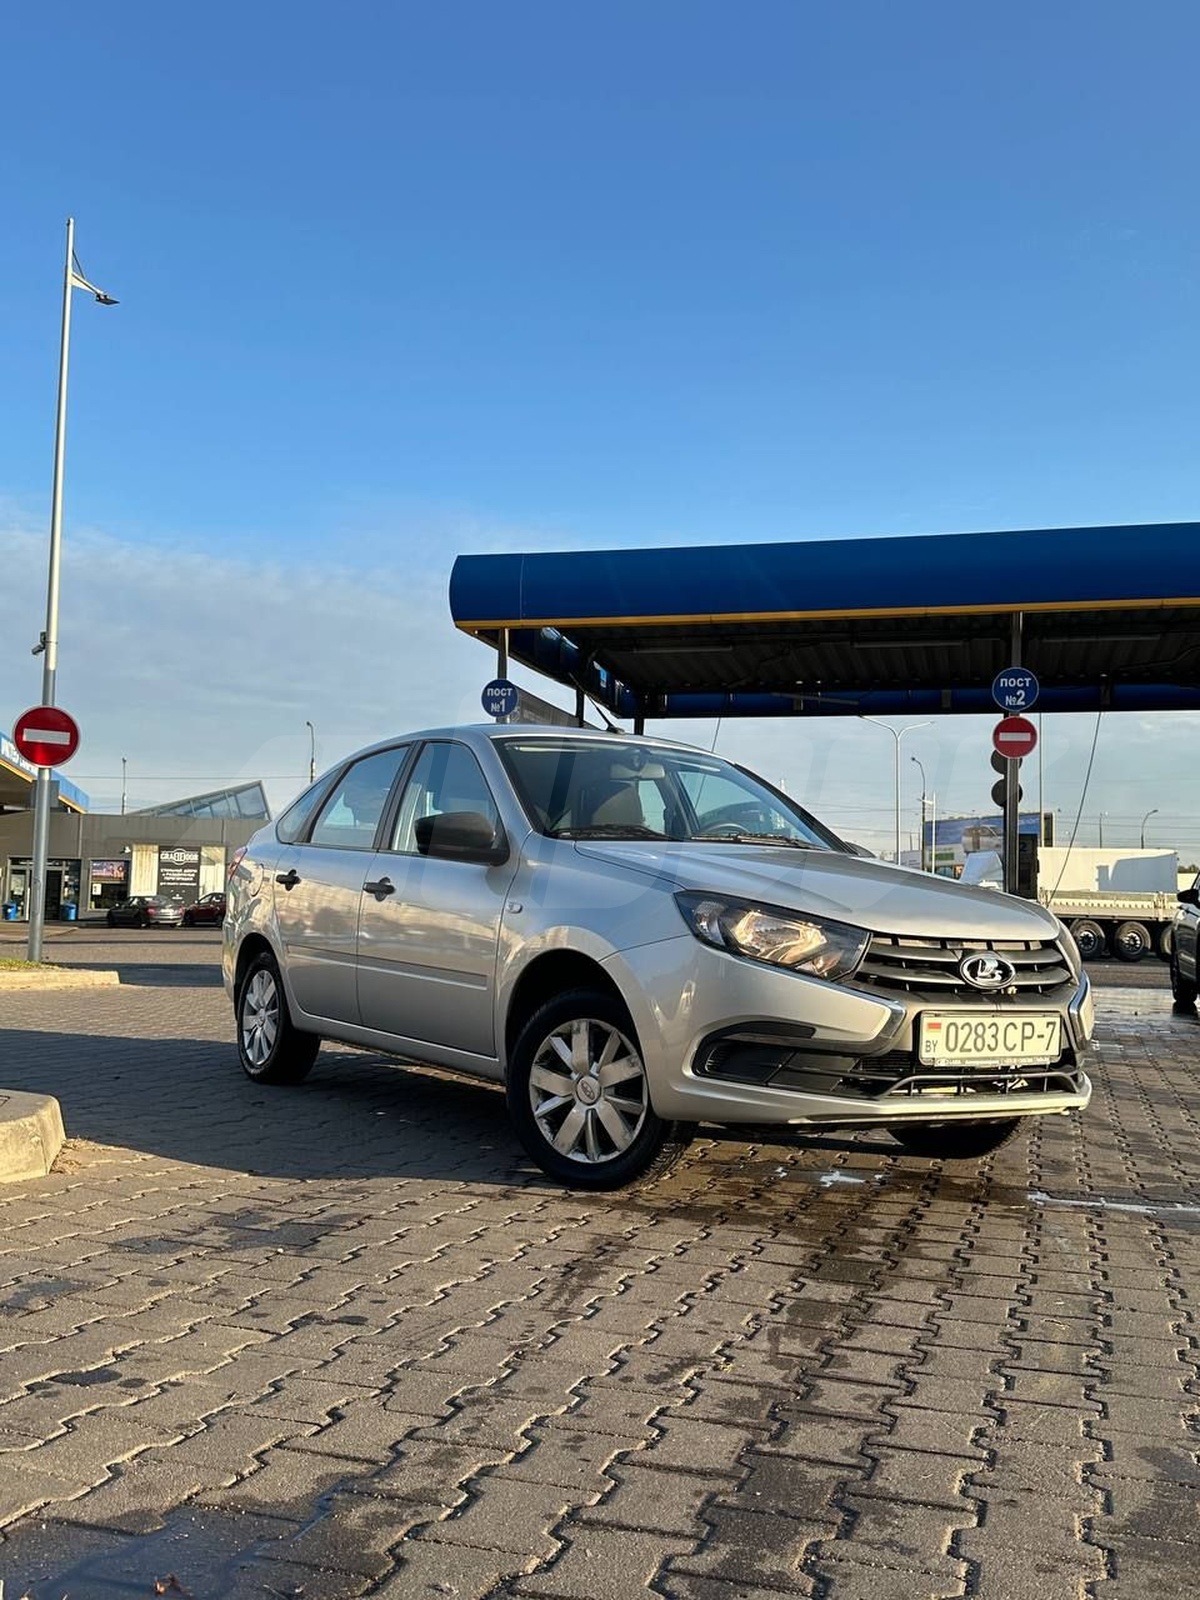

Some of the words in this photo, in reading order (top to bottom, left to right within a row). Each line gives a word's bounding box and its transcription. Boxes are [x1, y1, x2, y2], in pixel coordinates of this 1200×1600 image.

[490, 698, 506, 713] №1
[1005, 690, 1026, 707] №2
[925, 1039, 938, 1053] BY
